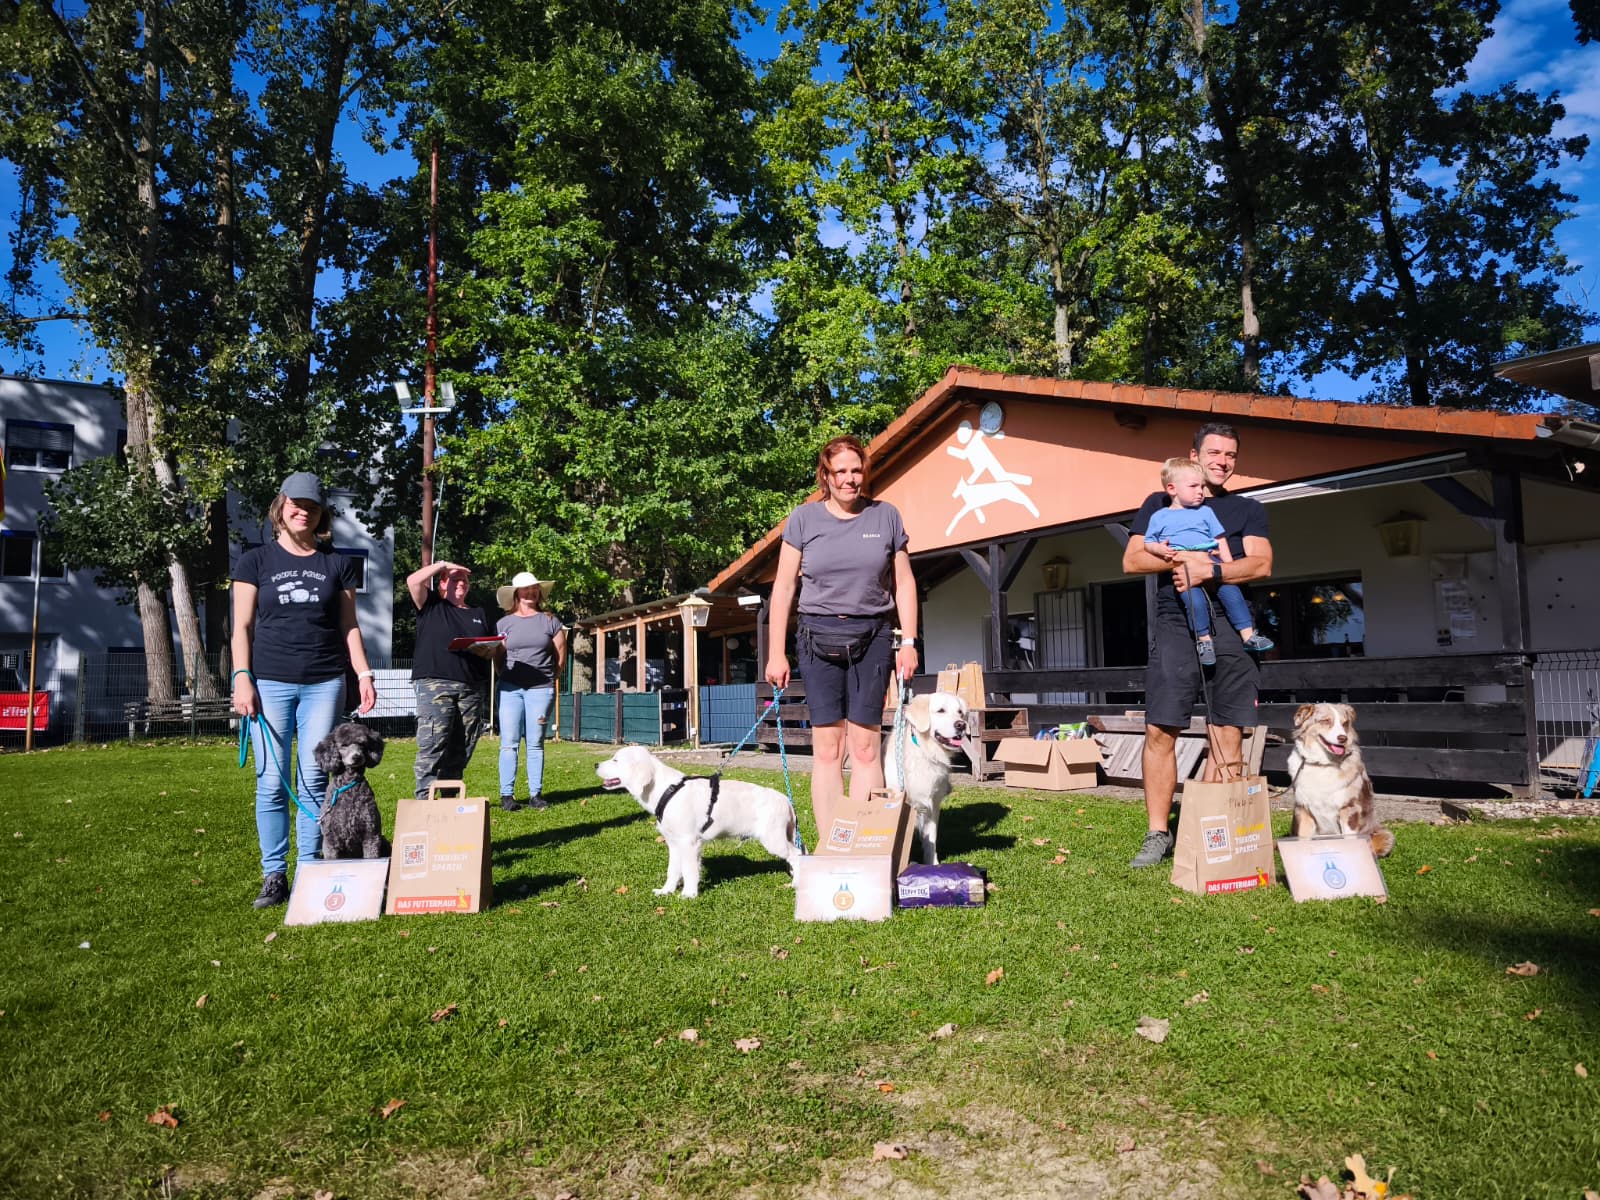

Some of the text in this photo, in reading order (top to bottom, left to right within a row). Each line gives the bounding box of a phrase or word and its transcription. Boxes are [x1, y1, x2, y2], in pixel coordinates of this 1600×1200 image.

[271, 570, 327, 582] POODLE POWER
[1208, 878, 1258, 892] DAS FUTTERHAUS
[331, 897, 338, 906] 3
[398, 899, 457, 909] DAS FUTTERHAUS
[841, 896, 846, 905] 1
